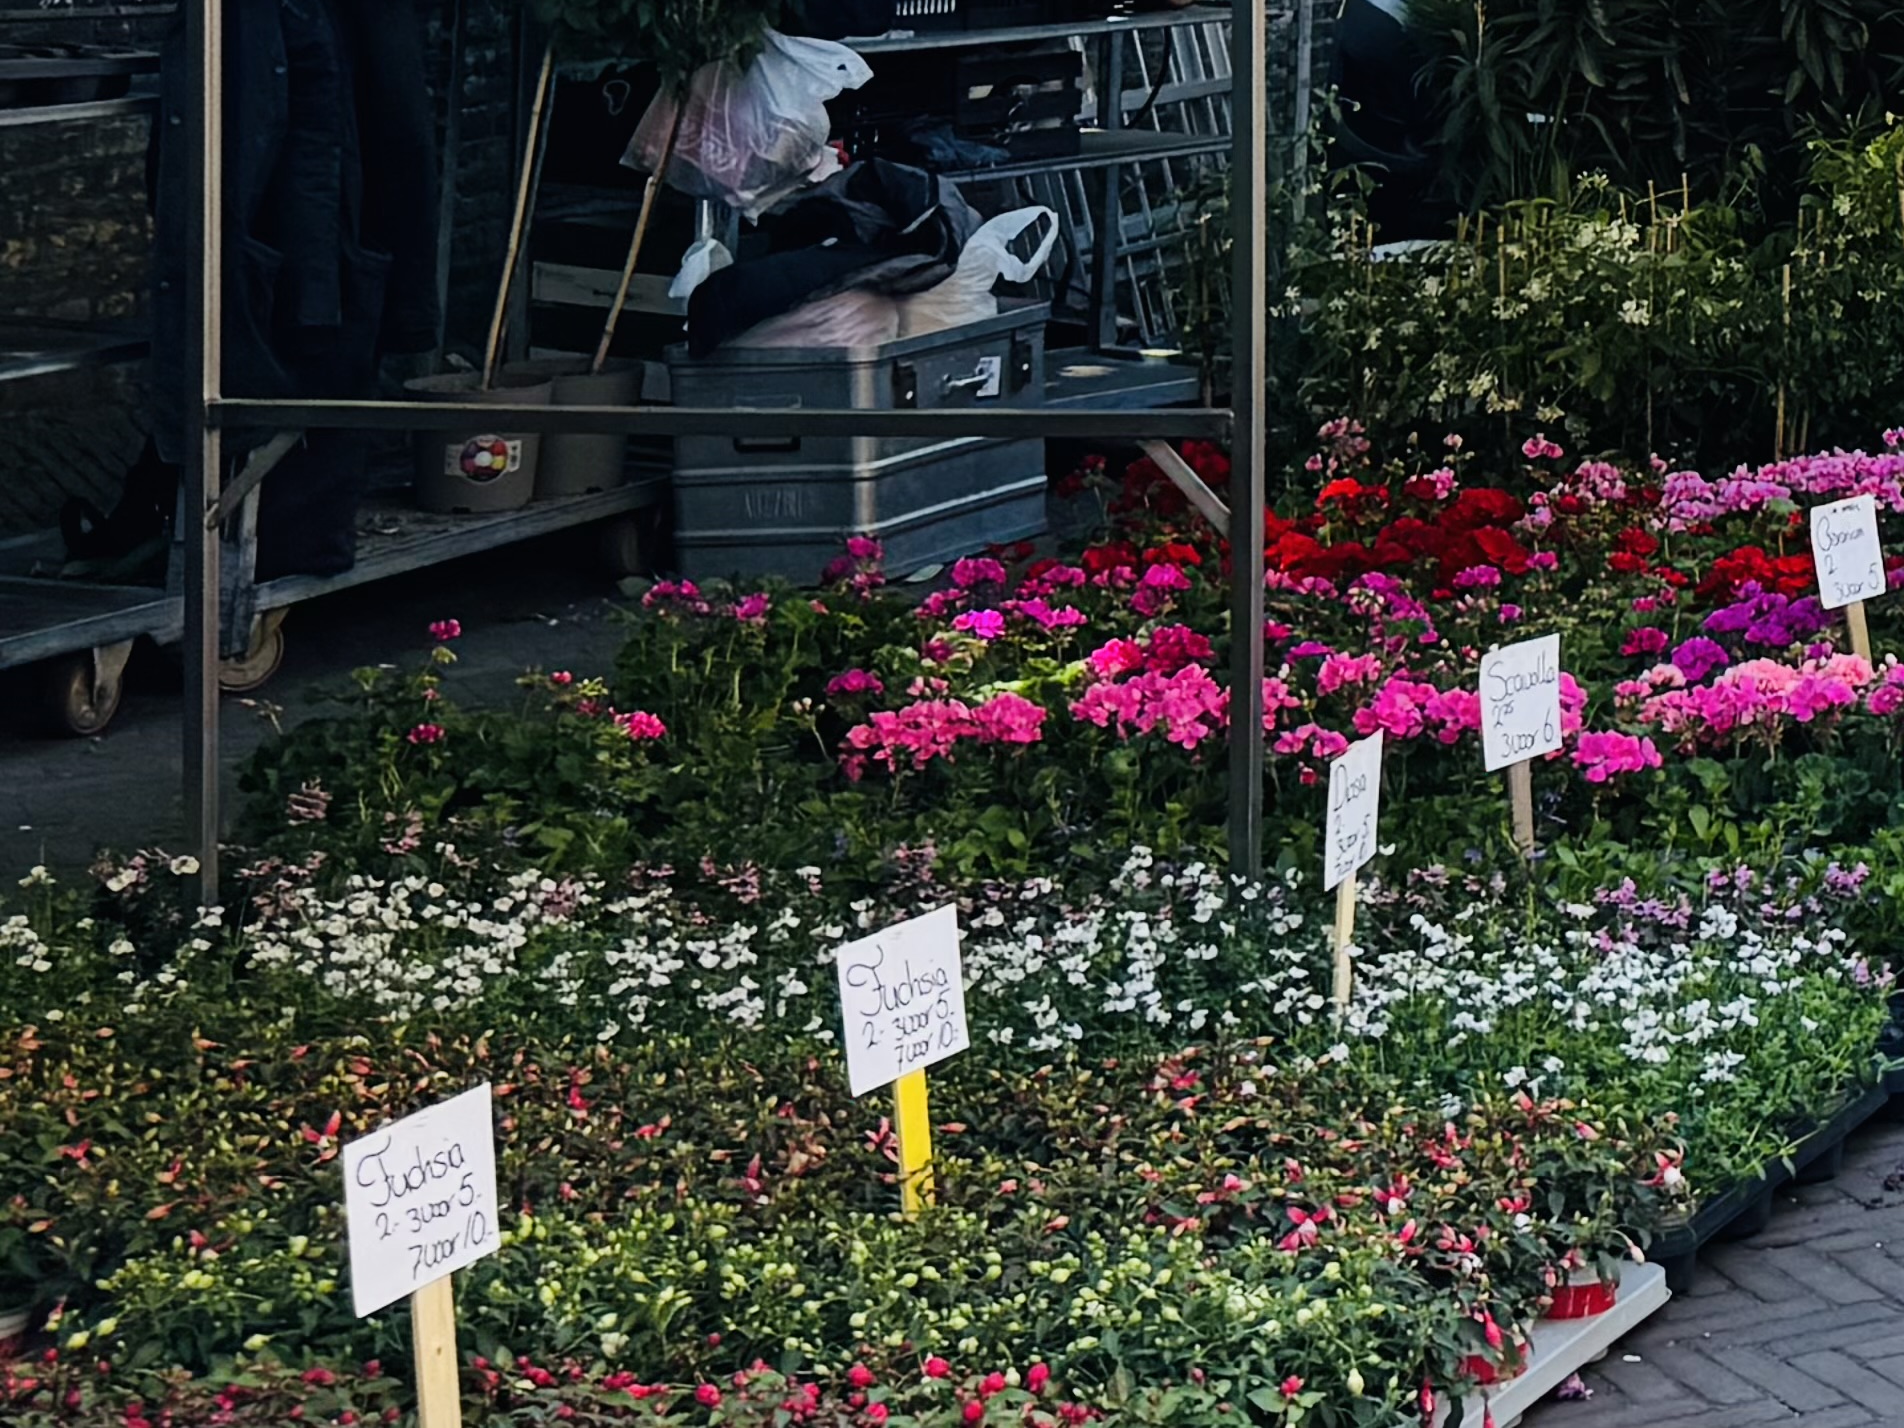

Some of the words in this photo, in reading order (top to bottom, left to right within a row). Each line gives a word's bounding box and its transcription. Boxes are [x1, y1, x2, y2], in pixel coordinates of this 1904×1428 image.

[1543, 706, 1554, 743] 6
[846, 944, 948, 1017] Fuchsia
[356, 1134, 465, 1207] Fuchsia
